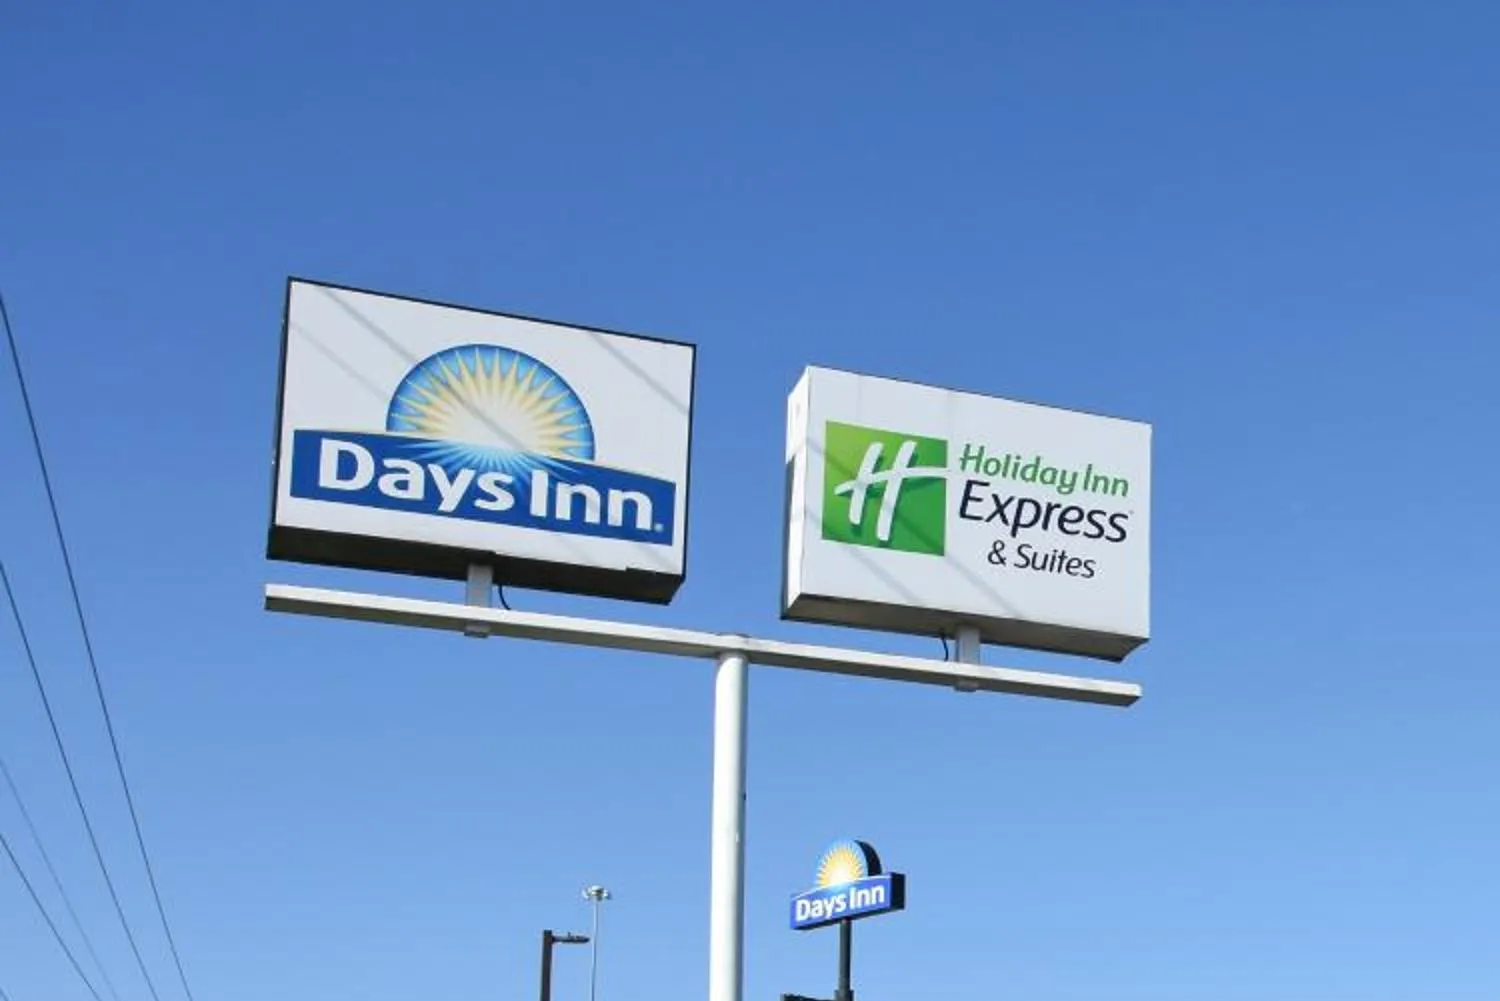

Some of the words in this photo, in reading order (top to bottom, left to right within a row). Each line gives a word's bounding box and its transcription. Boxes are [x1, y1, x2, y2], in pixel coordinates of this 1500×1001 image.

[318, 437, 515, 513] Days
[530, 469, 654, 532] Inn
[959, 443, 1080, 495] Holiday
[1082, 462, 1130, 498] Inn
[959, 479, 1130, 543] Express
[987, 539, 1007, 567] &
[1013, 543, 1097, 579] Suites
[795, 892, 847, 921] Days
[848, 885, 886, 910] Inn
